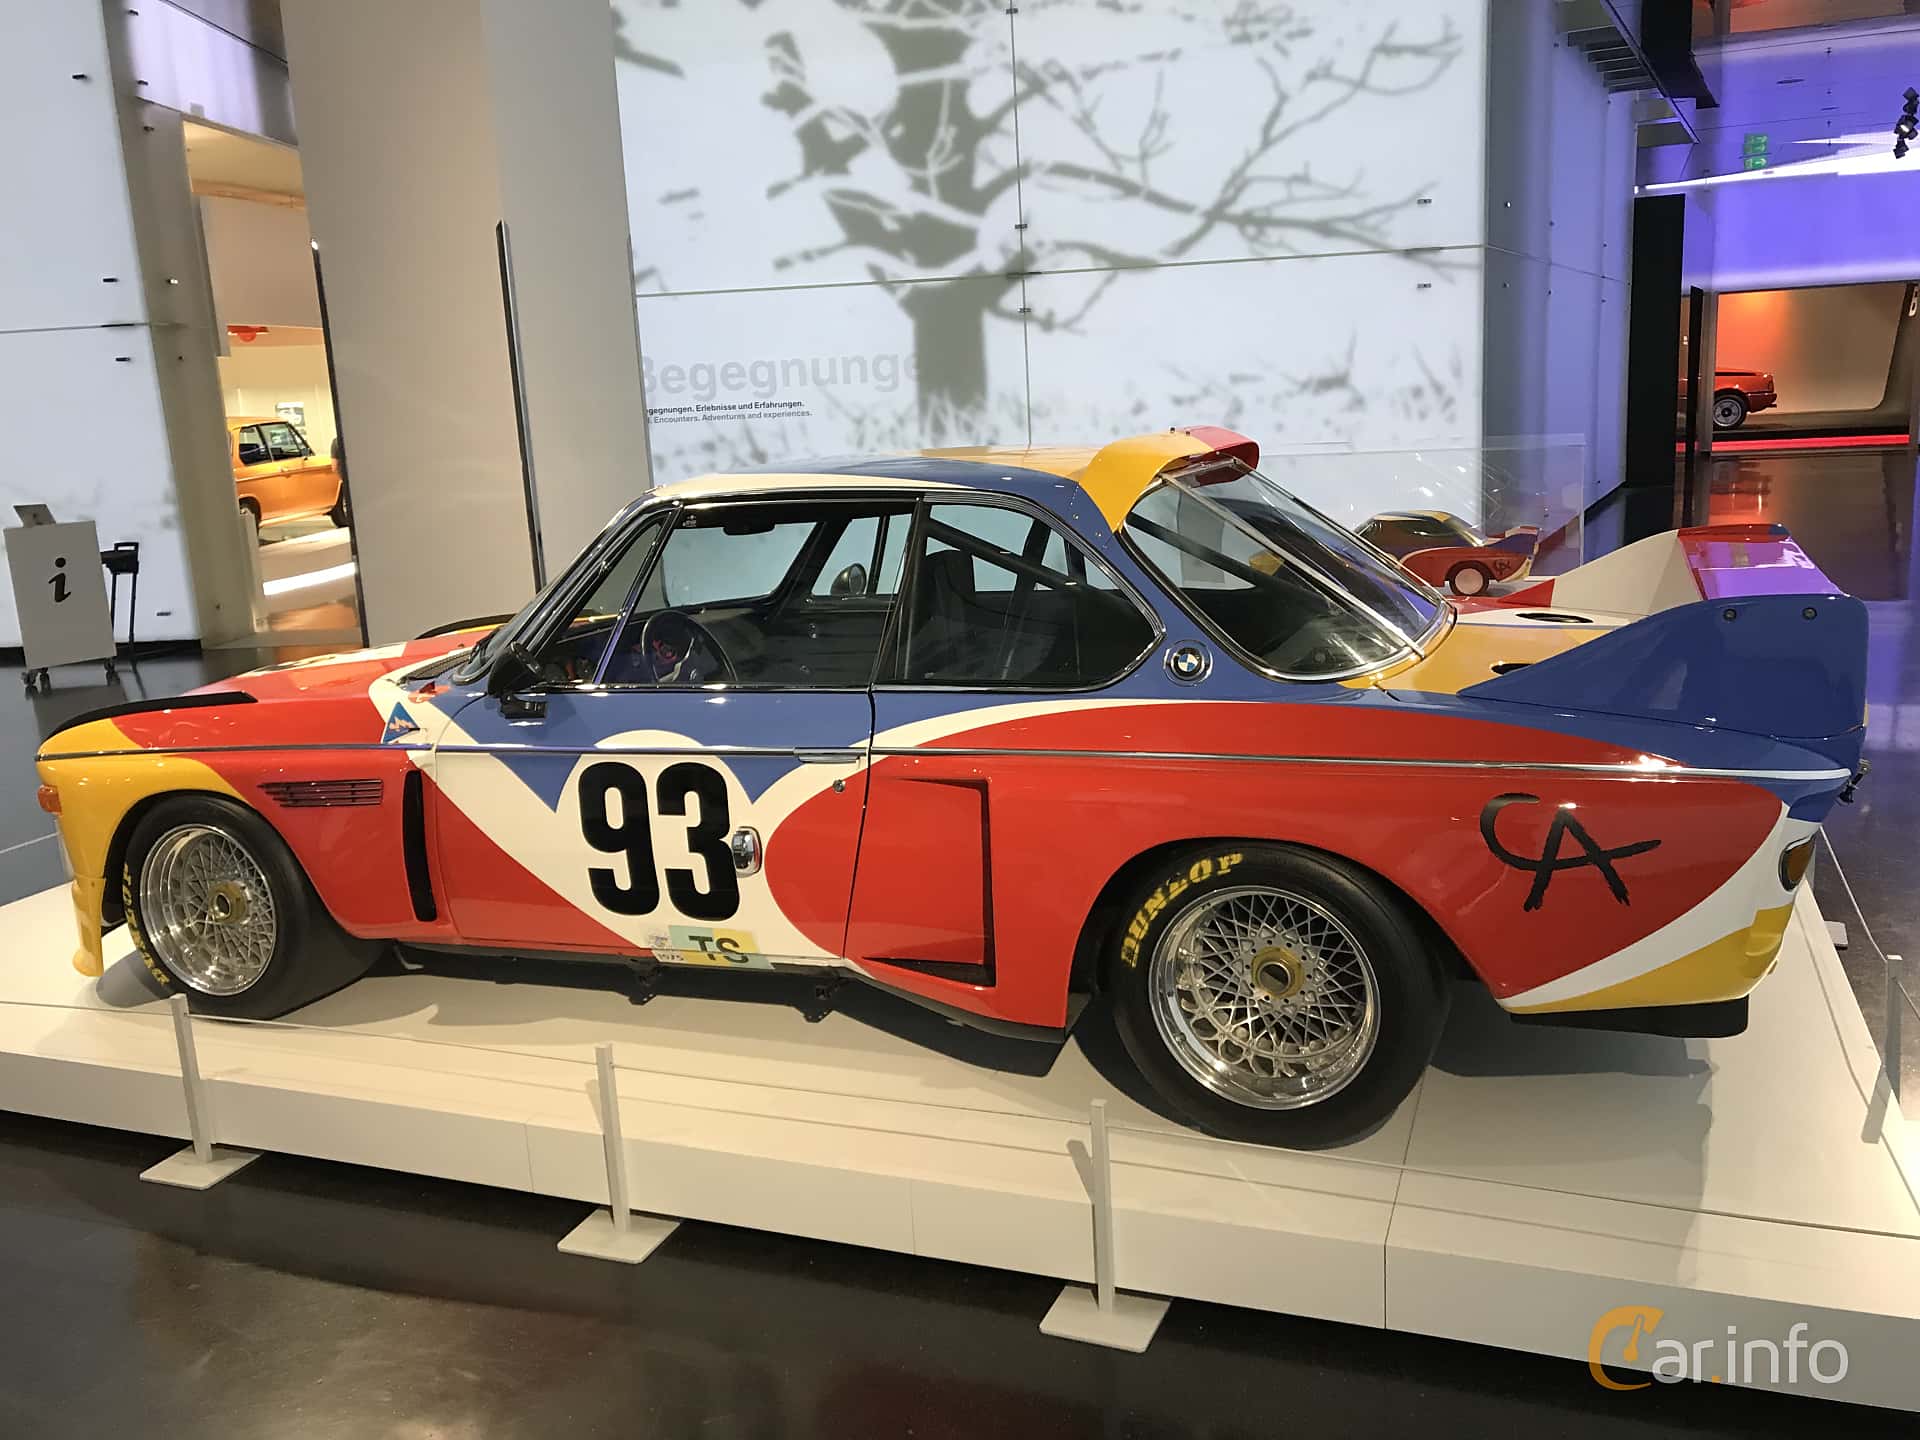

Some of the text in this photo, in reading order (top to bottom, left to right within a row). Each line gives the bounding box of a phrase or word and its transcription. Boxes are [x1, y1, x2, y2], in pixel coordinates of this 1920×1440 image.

[647, 400, 805, 416] gegnungen. Erlebnisse und Erfahrungen.
[654, 415, 701, 424] Encounters.
[702, 412, 746, 422] Adventures
[747, 411, 762, 420] and
[763, 409, 813, 419] experiences.
[578, 761, 740, 922] 93
[1121, 852, 1243, 968] DUNLOP
[688, 935, 749, 963] TS
